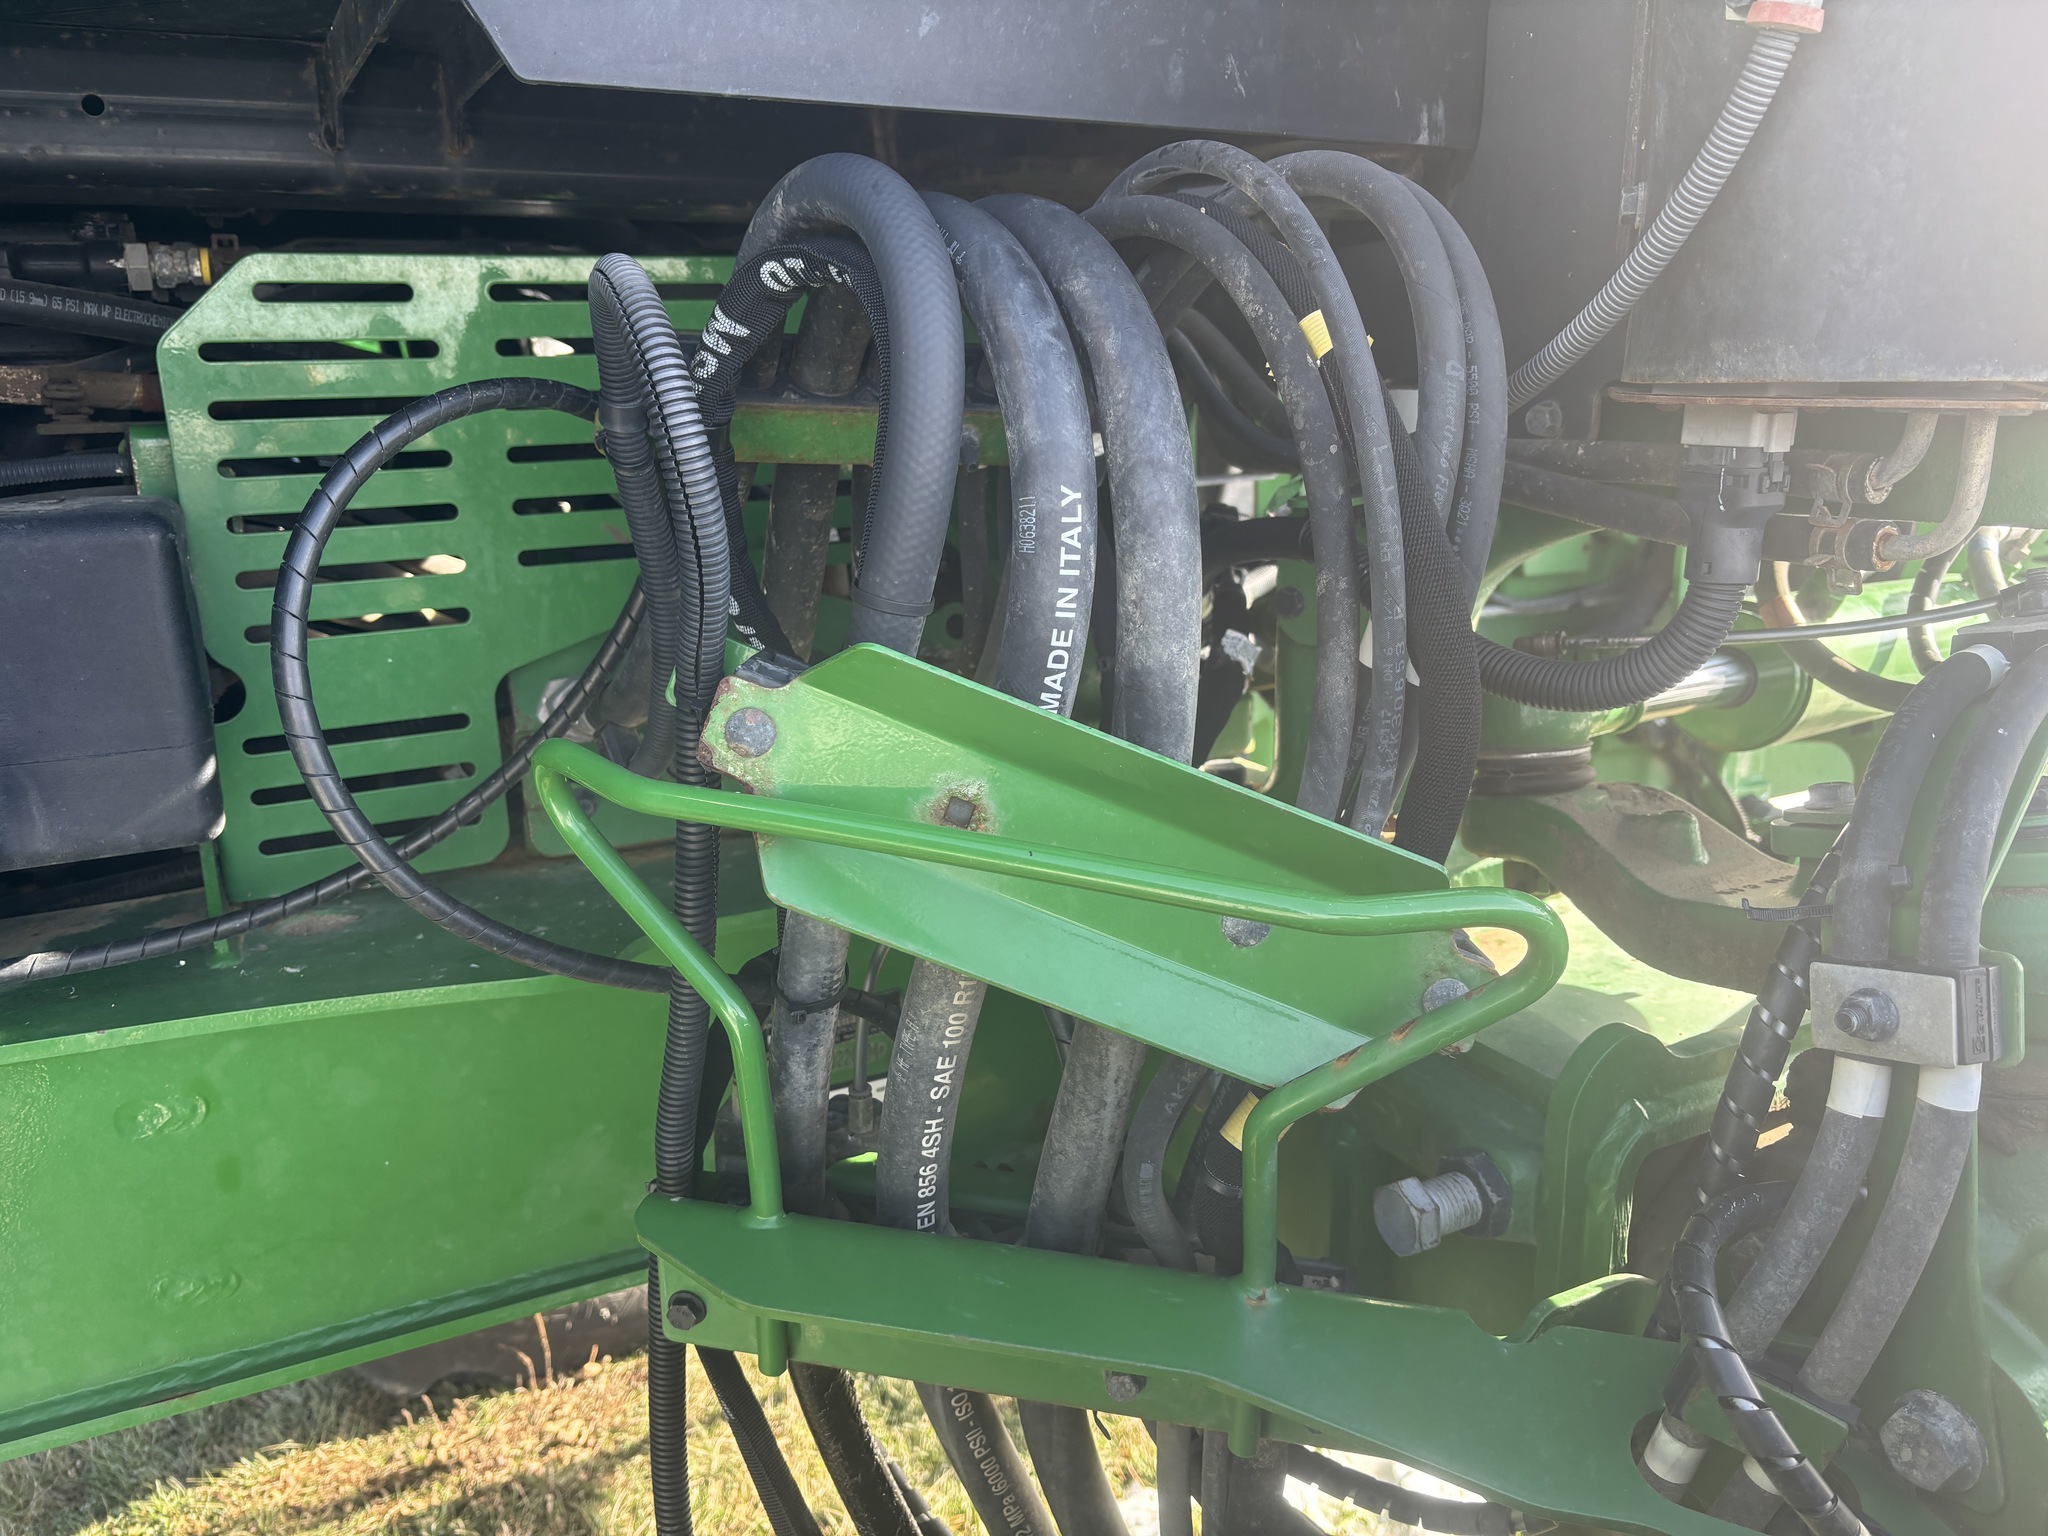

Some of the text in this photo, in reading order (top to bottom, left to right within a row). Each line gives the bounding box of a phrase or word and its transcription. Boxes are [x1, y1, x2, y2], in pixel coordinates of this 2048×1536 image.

[52, 296, 62, 310] 65
[65, 298, 80, 313] PSI
[83, 302, 99, 316] MAX
[101, 305, 112, 319] WP
[1039, 484, 1083, 714] MADE IN ITALY
[942, 1012, 968, 1049] 100
[930, 1054, 957, 1099] SAE
[921, 1117, 945, 1159] 4SH
[917, 1162, 938, 1198] 856
[916, 1200, 936, 1231] EN
[950, 1391, 973, 1421] ISO
[979, 1455, 1010, 1496] (6000
[1001, 1493, 1027, 1529] MPa
